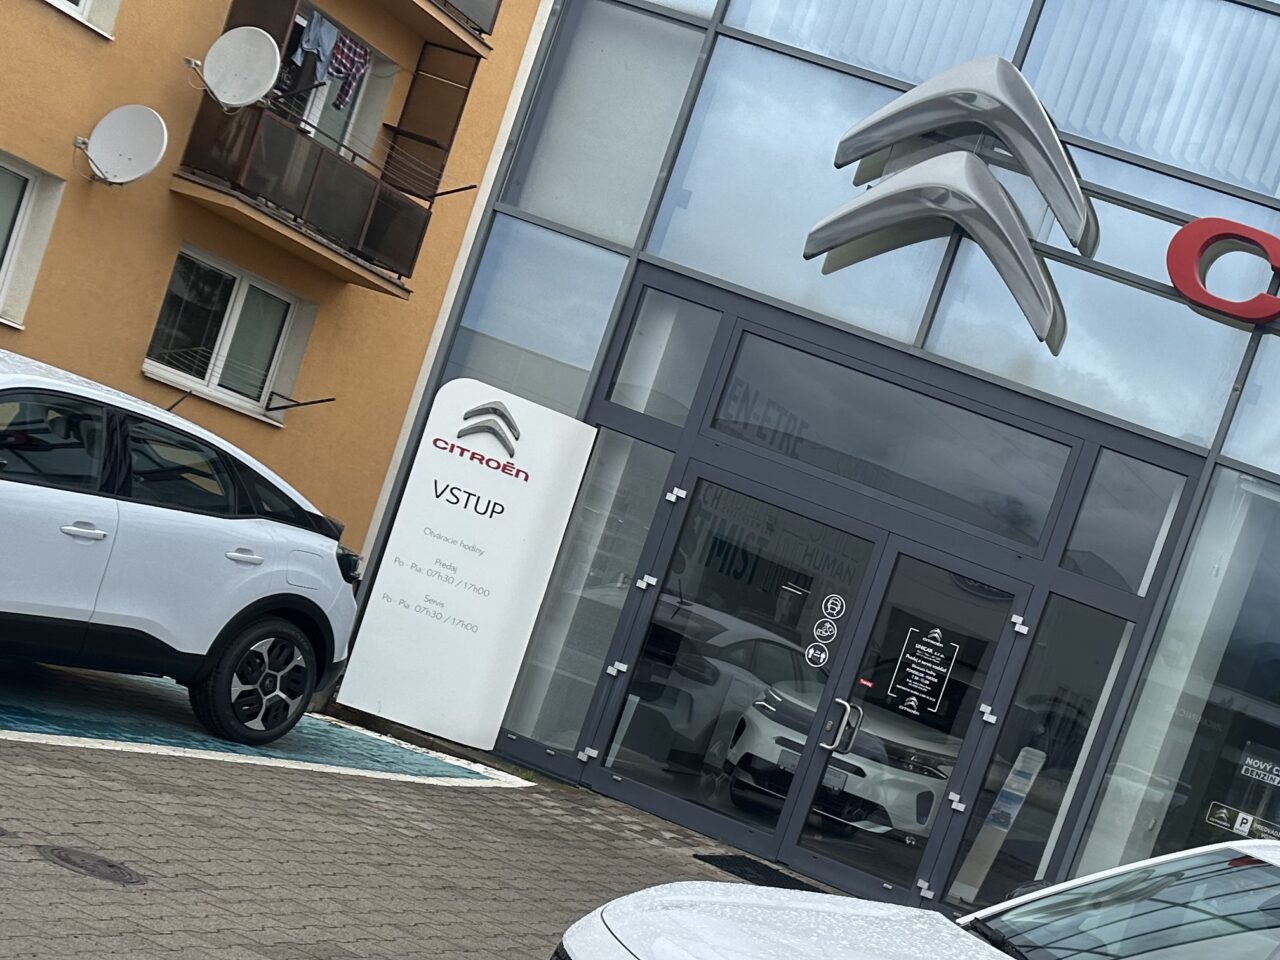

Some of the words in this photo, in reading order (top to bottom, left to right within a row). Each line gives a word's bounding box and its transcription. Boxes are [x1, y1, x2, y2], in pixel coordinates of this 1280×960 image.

[434, 479, 505, 519] VSTUP
[459, 539, 485, 557] hodiny
[434, 558, 458, 574] Predaj
[393, 556, 405, 567] Po
[426, 568, 455, 585] 07h30
[455, 579, 463, 588] /
[463, 581, 490, 598] 17h00
[423, 594, 445, 609] Servis
[382, 592, 392, 603] Po
[414, 604, 443, 620] 07h30
[443, 615, 451, 624] /
[452, 617, 479, 633] 17h00
[1245, 757, 1273, 771] NOVÝ
[1240, 817, 1248, 827] P
